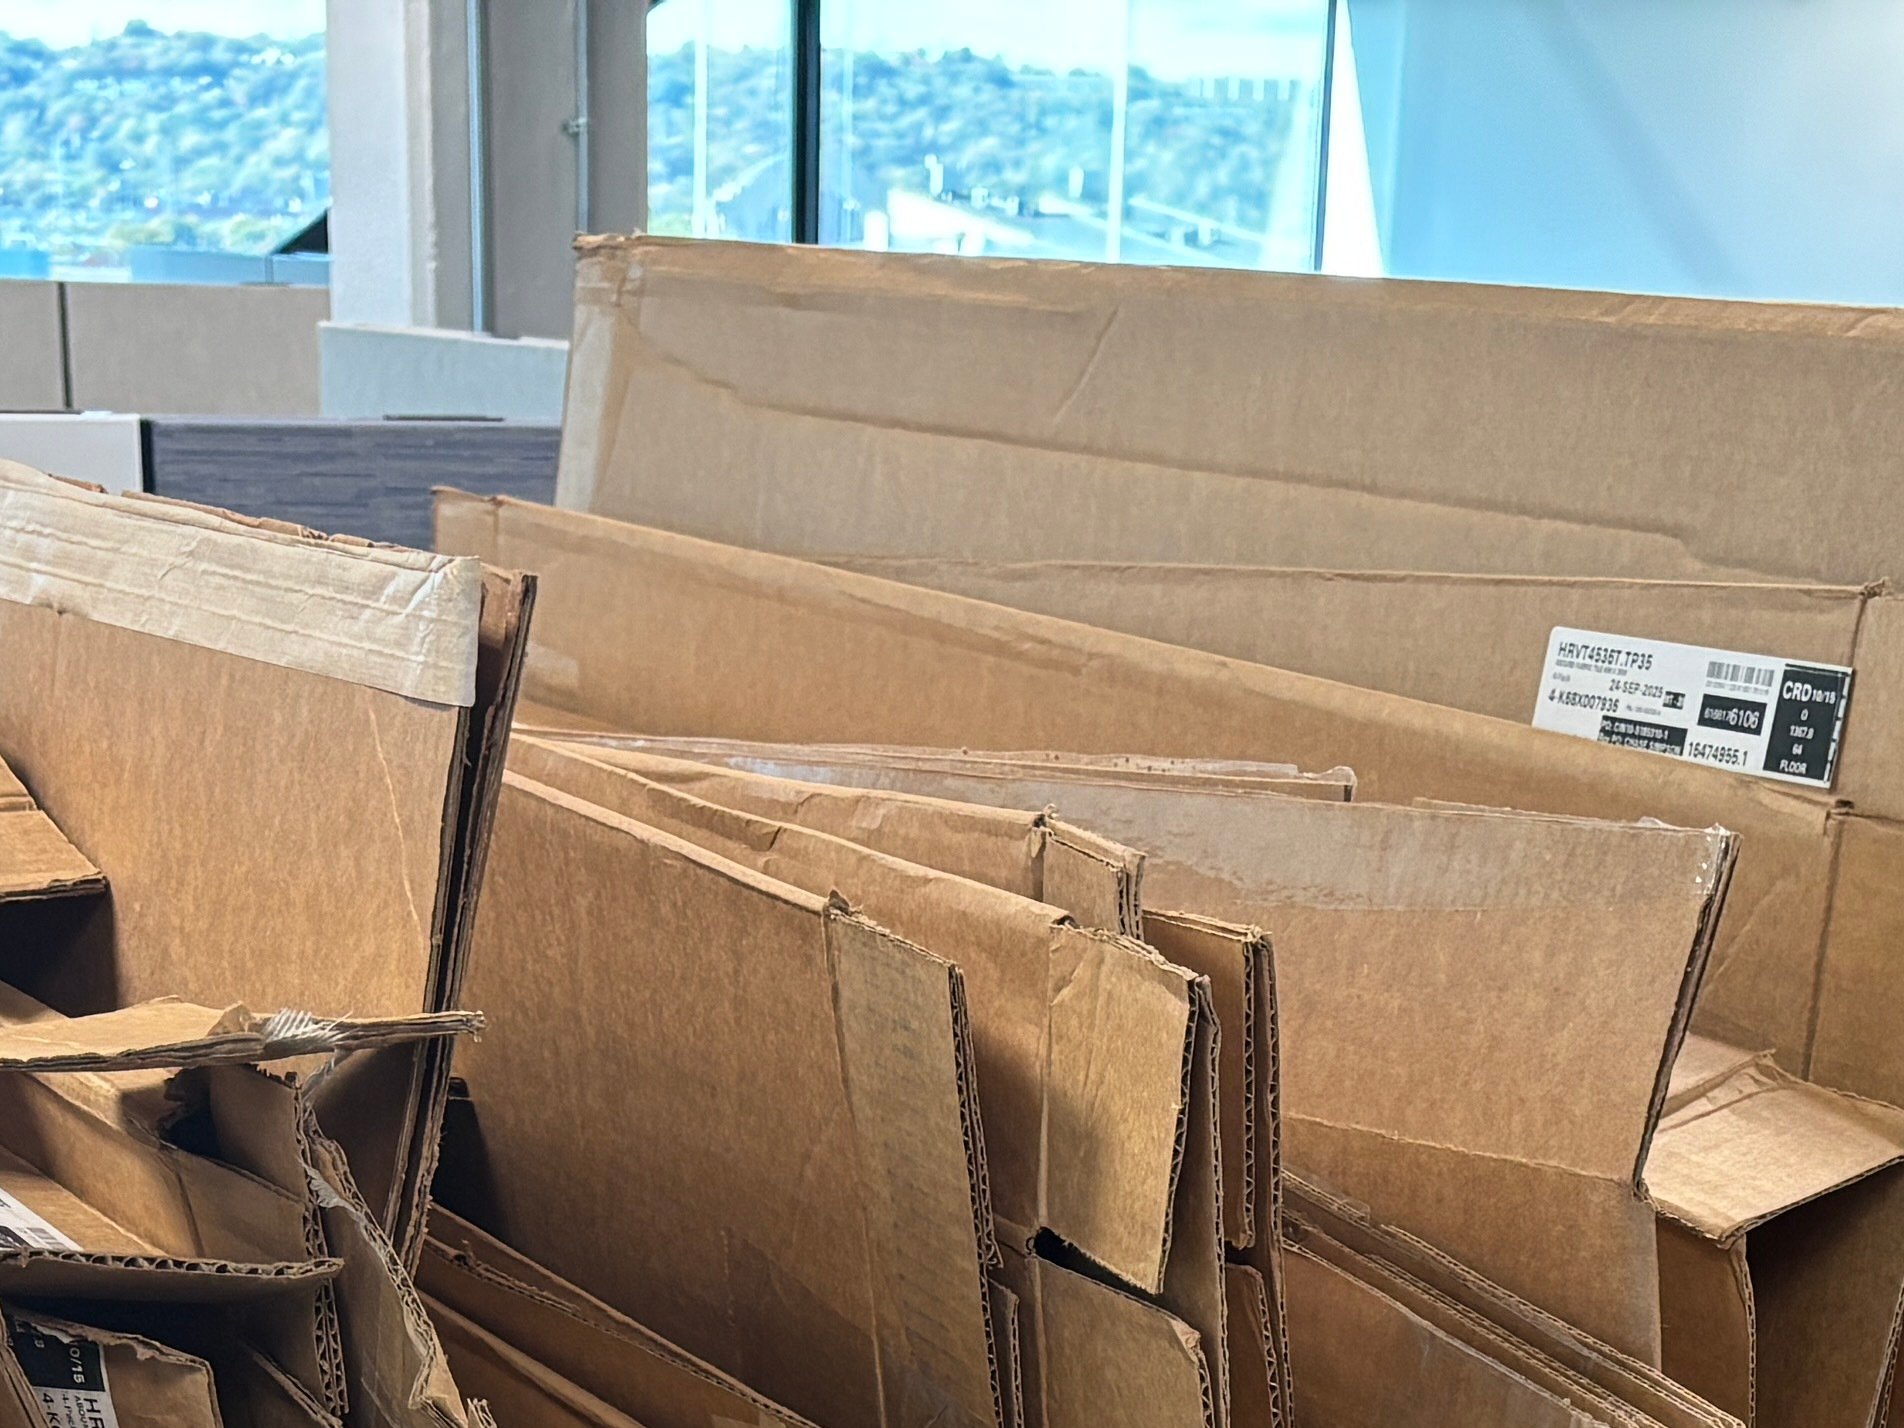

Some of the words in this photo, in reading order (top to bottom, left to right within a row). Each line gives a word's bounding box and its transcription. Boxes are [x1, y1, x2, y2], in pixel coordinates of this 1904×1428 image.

[1609, 679, 1664, 699] 24-SEP-2025
[1782, 680, 1812, 702] CRD
[1779, 759, 1807, 775] FLOOR
